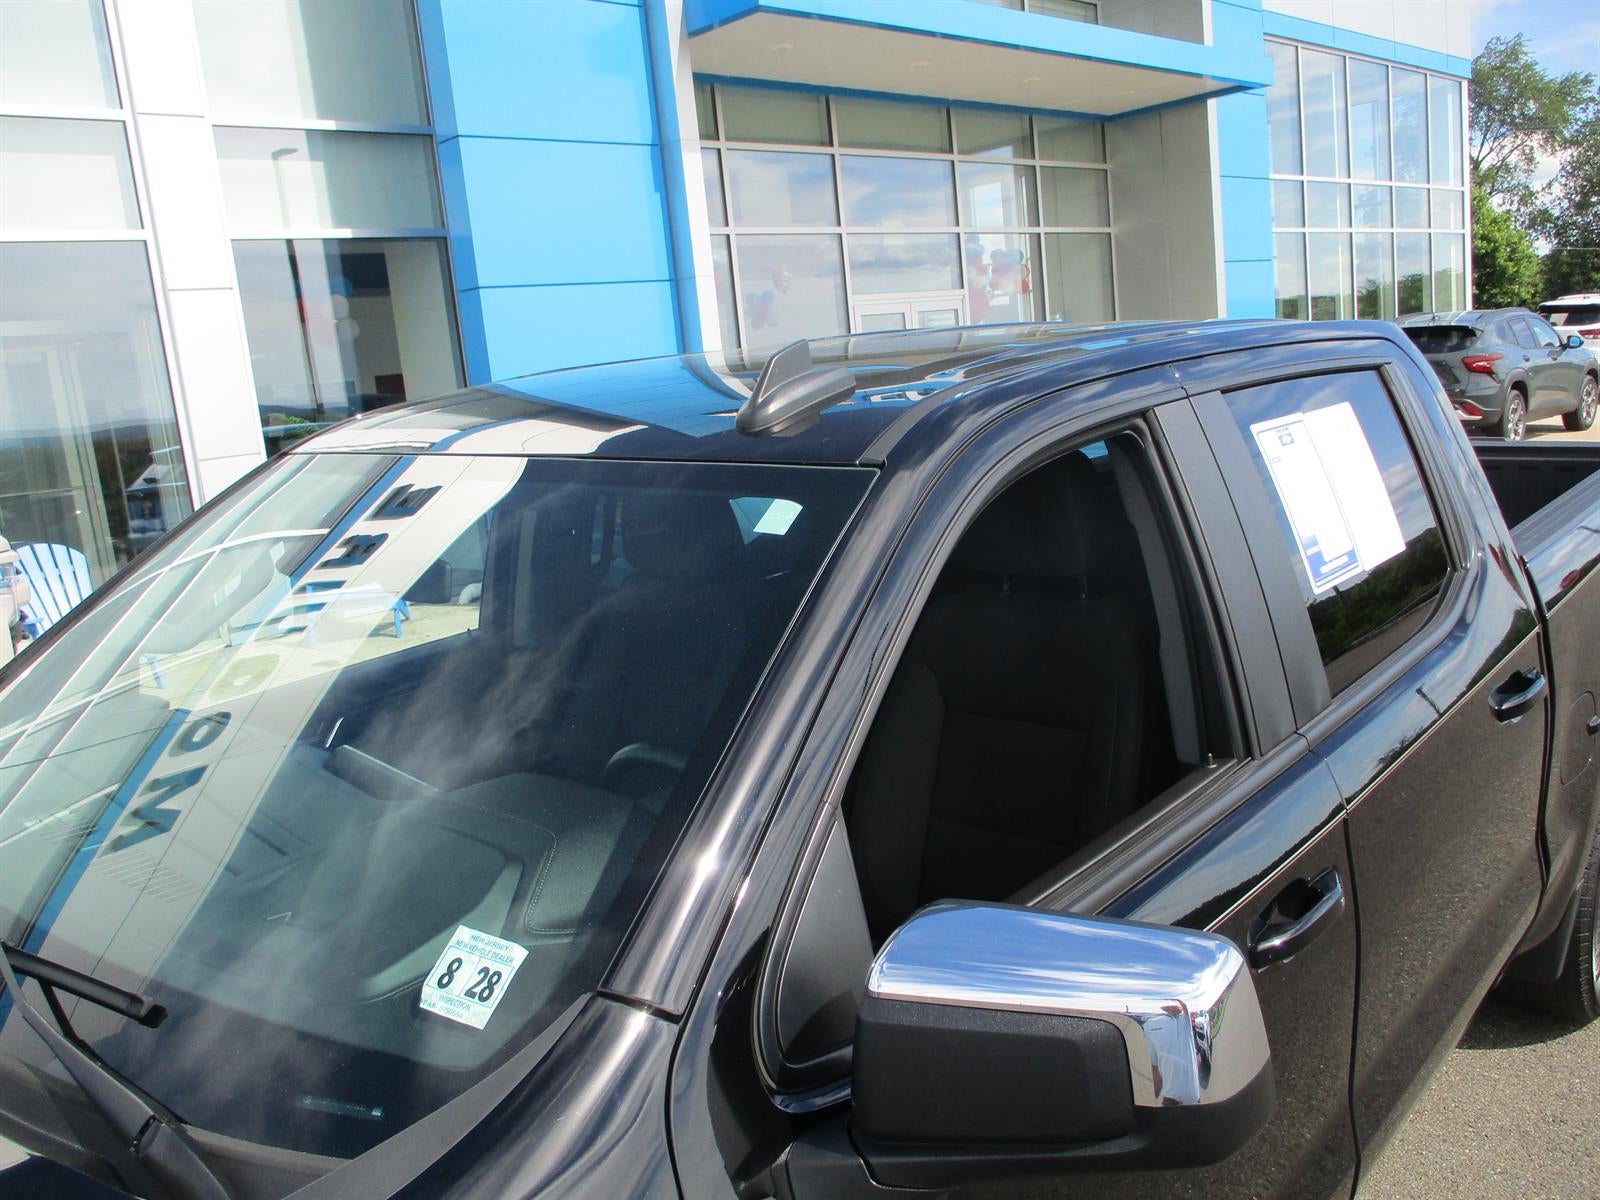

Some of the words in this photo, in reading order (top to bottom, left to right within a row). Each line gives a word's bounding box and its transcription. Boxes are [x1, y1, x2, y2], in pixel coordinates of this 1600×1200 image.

[468, 943, 492, 957] VEHICLE
[490, 950, 515, 964] DEALER
[484, 938, 510, 952] JERSEY
[437, 957, 463, 989] 8
[464, 966, 503, 1003] 28
